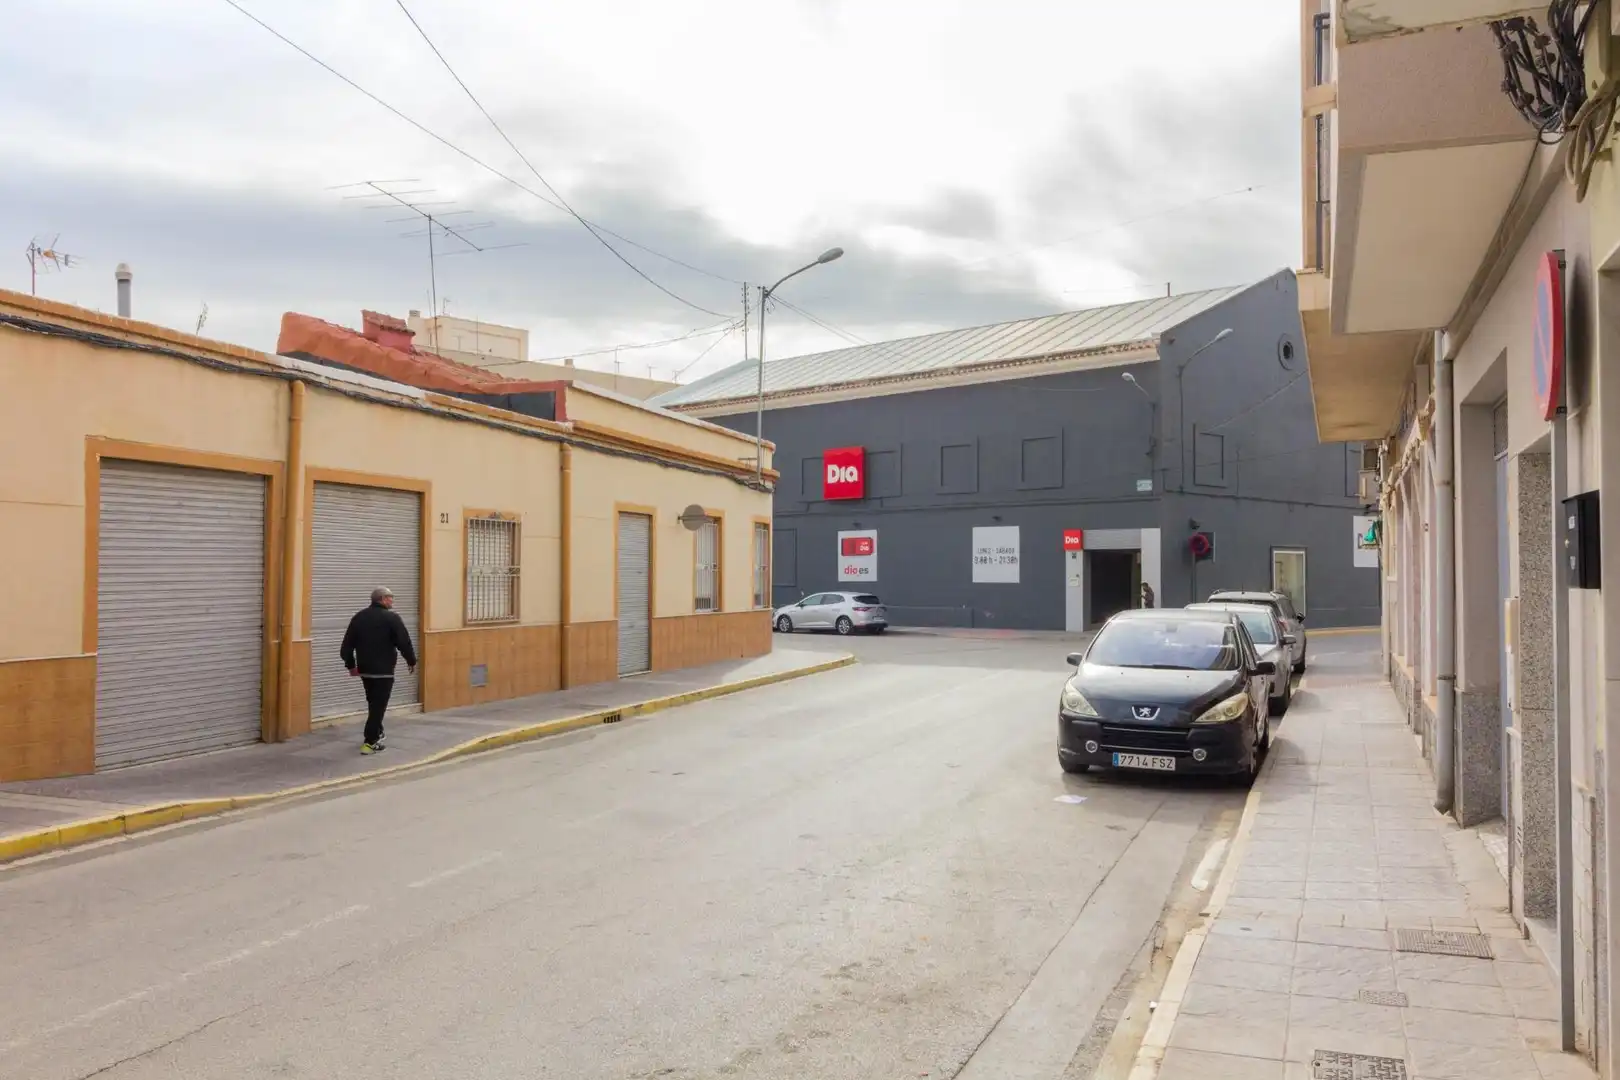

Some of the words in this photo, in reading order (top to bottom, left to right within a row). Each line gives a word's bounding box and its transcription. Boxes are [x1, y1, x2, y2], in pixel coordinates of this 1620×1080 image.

[440, 512, 449, 524] 21
[1121, 755, 1148, 767] 7714
[1151, 757, 1173, 769] FSZ
